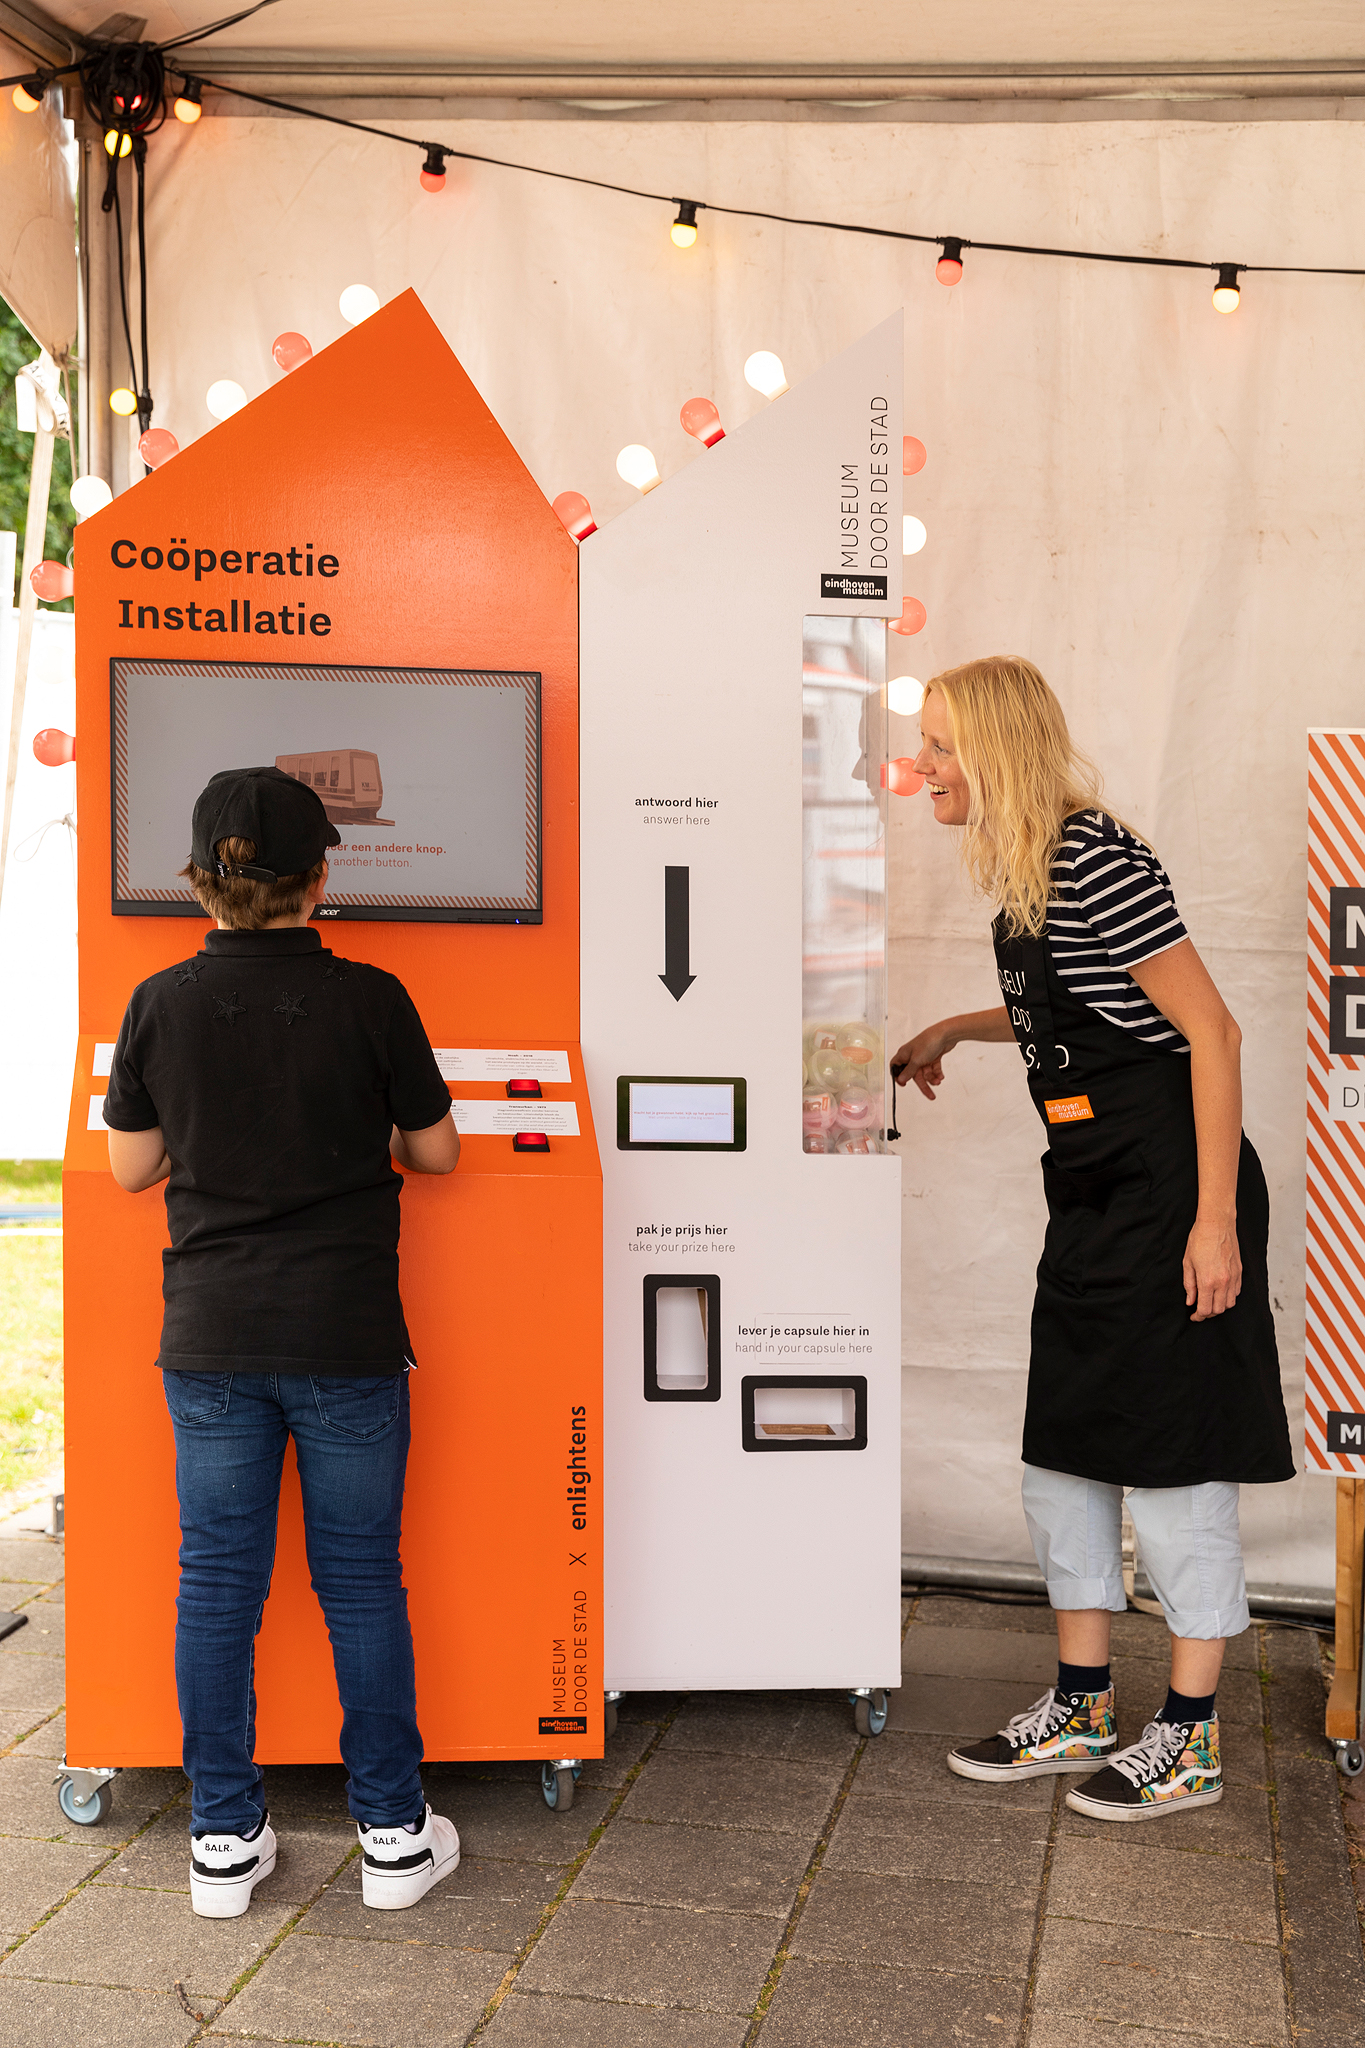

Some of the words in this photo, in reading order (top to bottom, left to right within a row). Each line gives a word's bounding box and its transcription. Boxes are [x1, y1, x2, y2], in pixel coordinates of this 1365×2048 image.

[870, 396, 889, 456] STAD
[870, 463, 889, 493] DE
[841, 464, 859, 568] MUSEUM
[870, 501, 889, 569] DOOR
[111, 538, 340, 581] Coöperatie
[824, 577, 875, 589] eindhoven
[842, 586, 885, 597] museum
[118, 599, 332, 637] Installatie
[634, 797, 692, 808] antwoord
[695, 797, 719, 808] hier
[643, 815, 683, 825] answer
[685, 815, 711, 826] here
[351, 843, 371, 852] een
[374, 843, 413, 854] andere
[415, 843, 447, 856] knop.
[333, 857, 373, 868] another
[375, 857, 412, 868] button.
[319, 908, 340, 916] acer
[1058, 1107, 1089, 1120] museum
[636, 1224, 658, 1237] pak
[660, 1224, 672, 1237] je
[675, 1224, 702, 1237] prijs
[705, 1224, 728, 1235] hier
[628, 1241, 653, 1252] take
[654, 1243, 679, 1255] your
[681, 1241, 709, 1254] prize
[711, 1242, 736, 1253] here
[738, 1325, 768, 1336] lever
[769, 1325, 781, 1339] je
[784, 1325, 830, 1339] capsule
[833, 1325, 856, 1336] hier
[859, 1325, 870, 1336] in
[735, 1342, 762, 1353] hand
[765, 1342, 775, 1353] in
[777, 1344, 802, 1356] your
[803, 1342, 846, 1355] capsule
[848, 1342, 873, 1353] here
[567, 1405, 592, 1531] enlightens
[569, 1552, 587, 1566] X
[573, 1590, 588, 1633] STAD
[573, 1637, 588, 1659] DE
[552, 1639, 567, 1713] MUSEUM
[573, 1663, 588, 1712] DOOR
[541, 1720, 578, 1728] eindhoven
[204, 1843, 233, 1852] BALR.
[372, 1836, 401, 1845] BALR.
